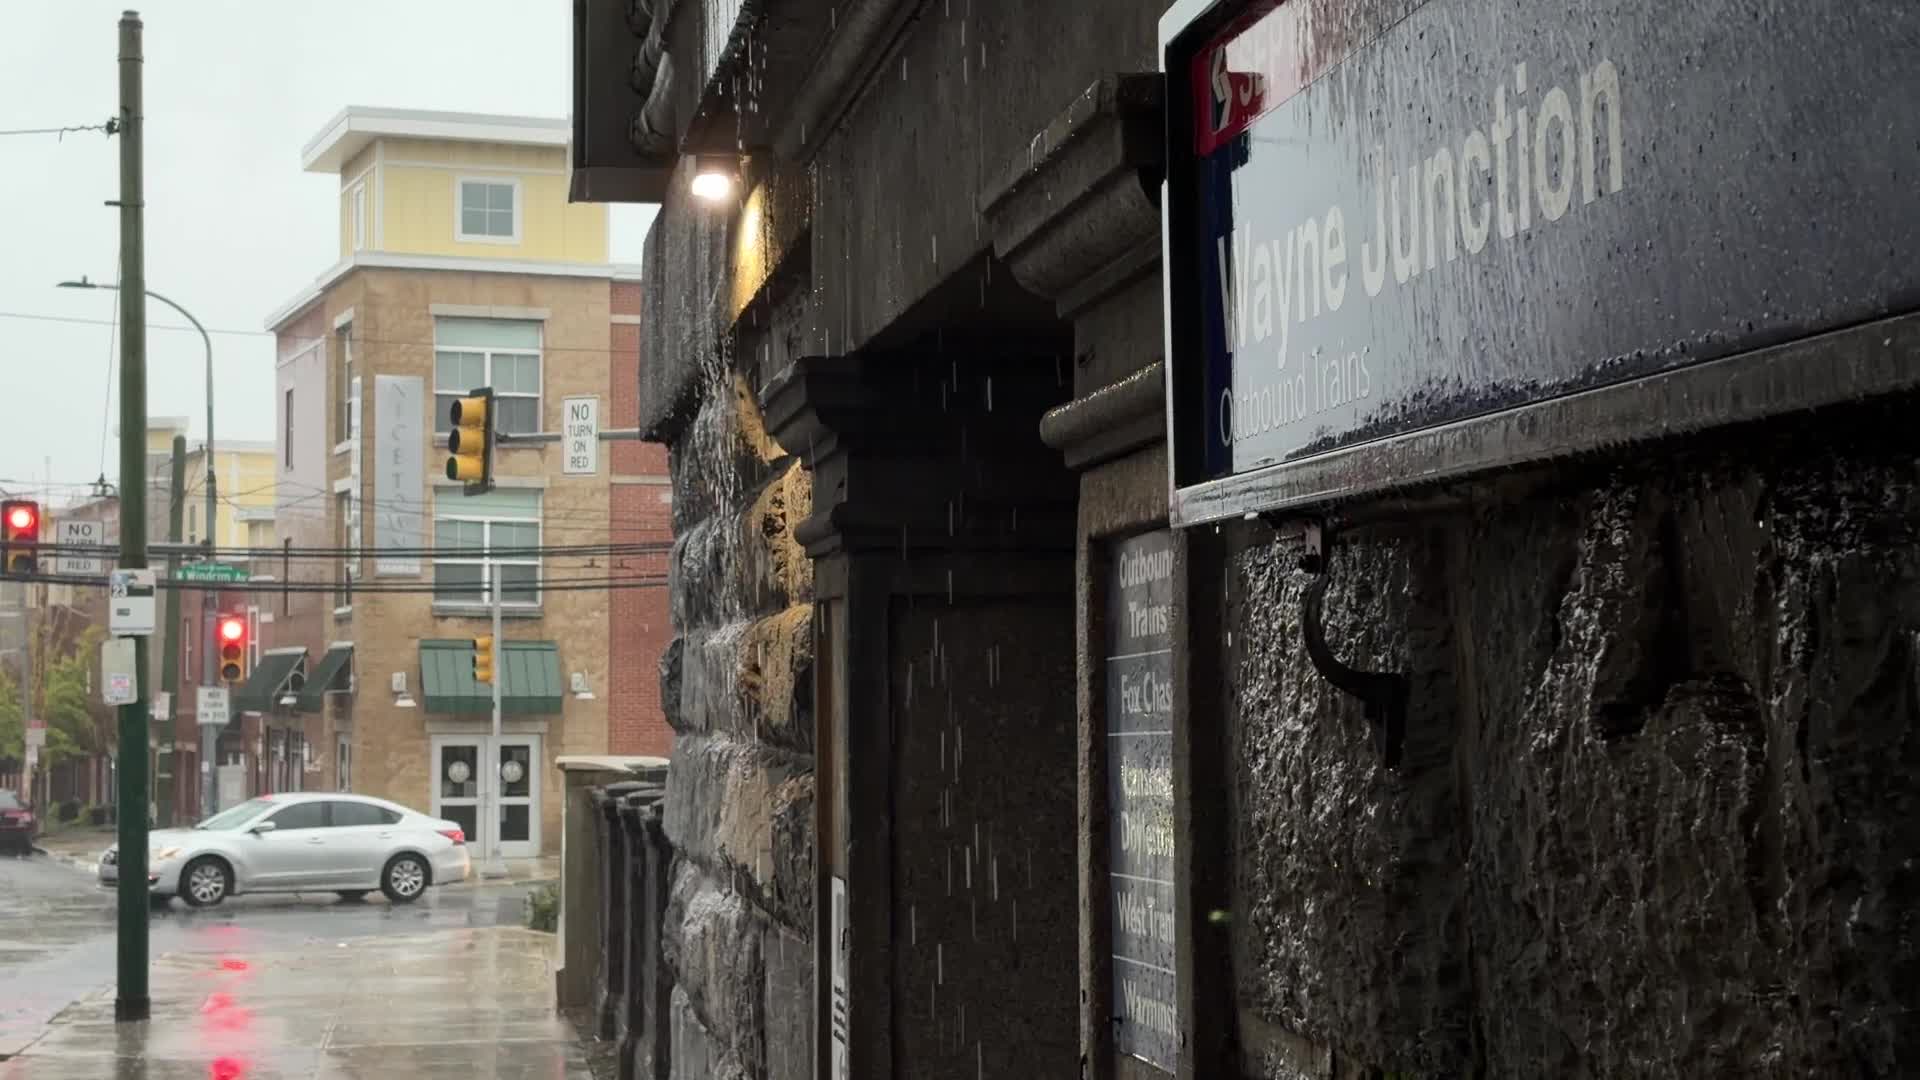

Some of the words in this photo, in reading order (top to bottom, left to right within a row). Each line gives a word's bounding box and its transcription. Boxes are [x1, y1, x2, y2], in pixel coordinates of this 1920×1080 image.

[1218, 205, 1348, 369] Wayne
[1361, 59, 1623, 297] Junction
[1310, 338, 1371, 415] Trains
[571, 404, 589, 419] NO
[568, 425, 593, 437] TURN
[573, 440, 586, 452] ON
[570, 456, 588, 468] RED
[68, 523, 92, 536] NO
[67, 560, 91, 569] RED
[111, 585, 128, 597] 23
[1127, 597, 1168, 638] Trains
[1121, 674, 1142, 714] Fox
[1116, 891, 1147, 937] West
